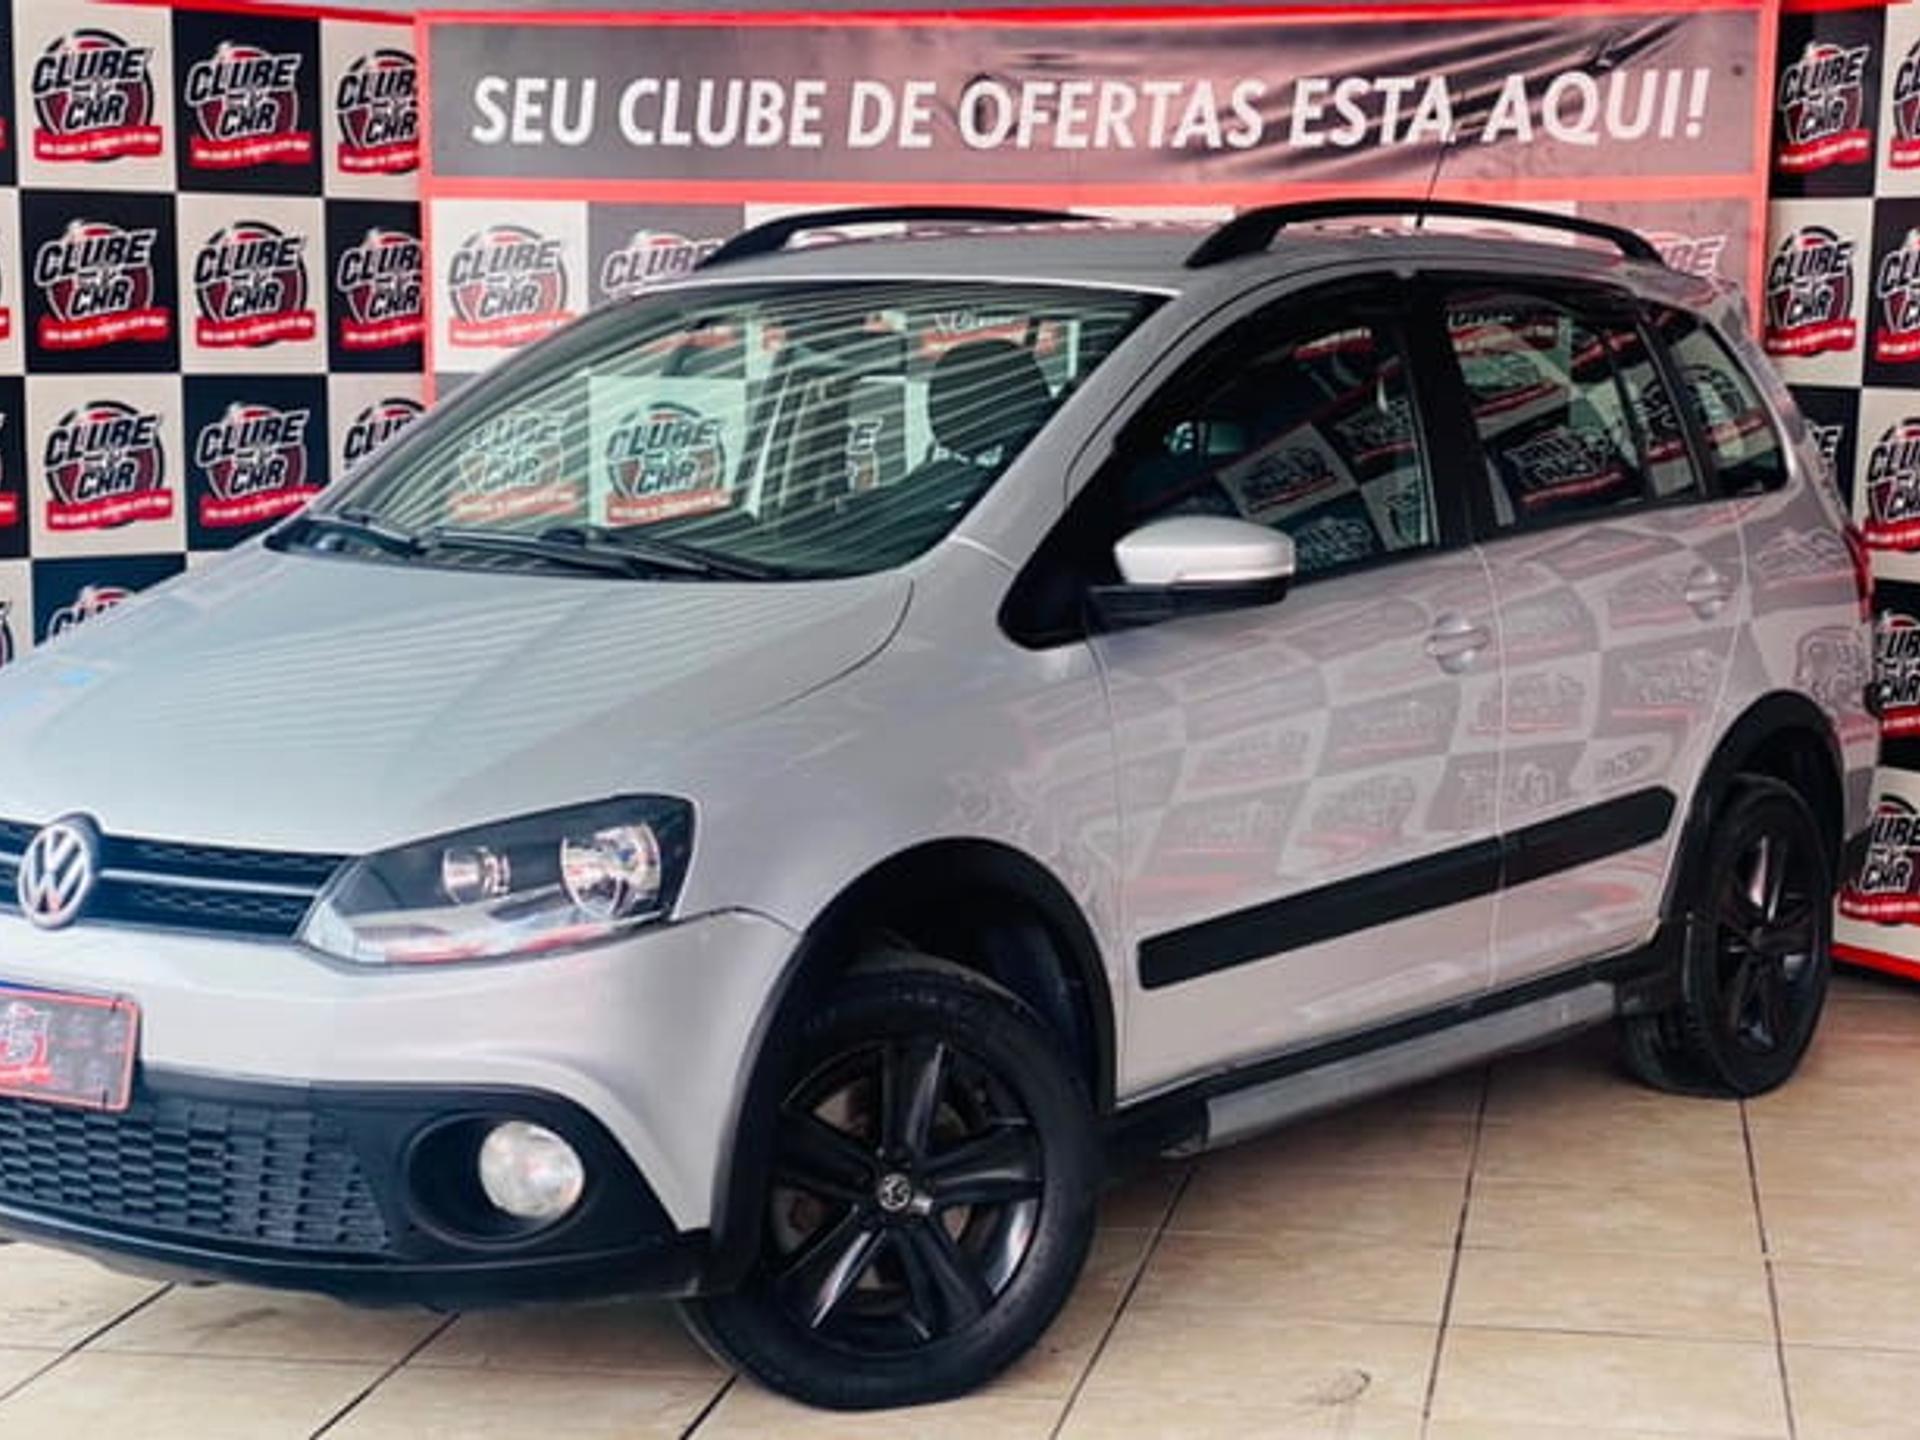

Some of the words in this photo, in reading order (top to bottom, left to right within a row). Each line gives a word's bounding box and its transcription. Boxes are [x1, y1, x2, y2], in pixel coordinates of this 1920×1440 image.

[32, 47, 146, 94] CLUBE
[188, 56, 297, 102] CLUBE
[337, 69, 416, 109] CLUB
[472, 76, 597, 144] SEU
[618, 78, 826, 147] CLUBE
[847, 80, 936, 149] DE
[958, 79, 1268, 149] OFERTAS
[1288, 75, 1456, 146] ESTA
[1480, 68, 1710, 146] AQUI!
[39, 234, 150, 283] CLUBE
[194, 238, 300, 283] CLUBE
[341, 244, 421, 287] CLUB
[449, 241, 560, 285] CLUBE
[46, 415, 157, 466] CLUBE
[199, 411, 305, 462] CLUBE
